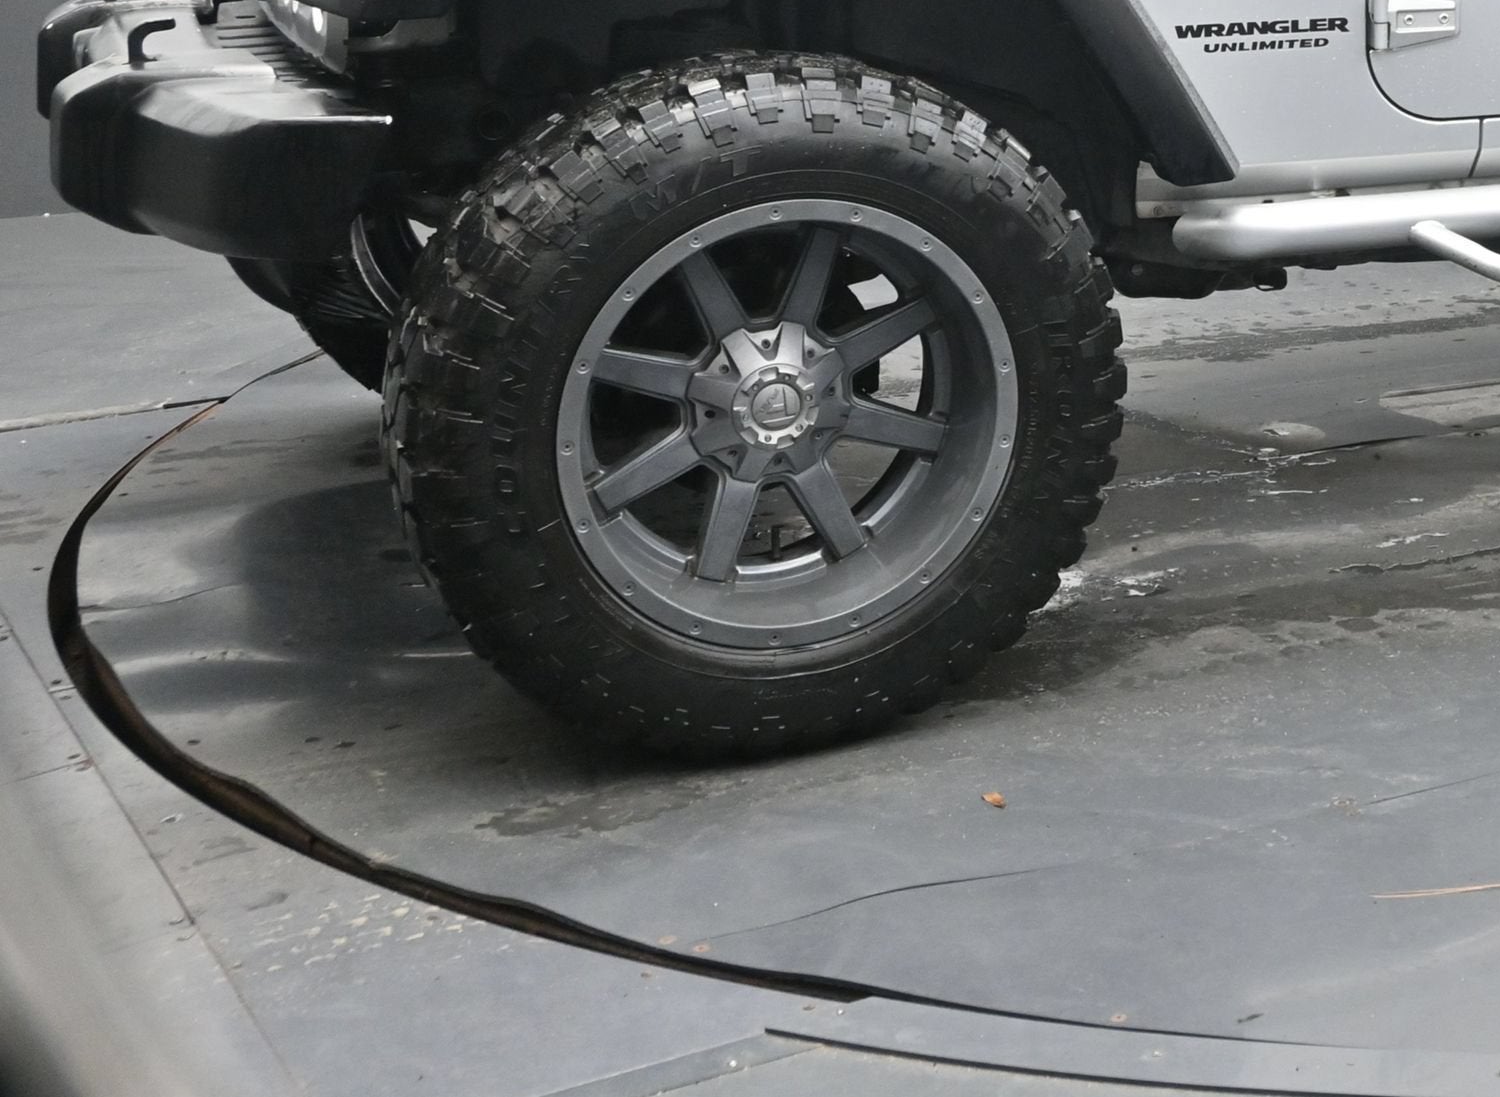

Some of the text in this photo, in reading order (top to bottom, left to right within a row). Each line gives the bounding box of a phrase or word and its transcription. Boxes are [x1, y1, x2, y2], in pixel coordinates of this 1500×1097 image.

[1174, 17, 1350, 39] WRANGLER
[1203, 38, 1330, 53] UNLIMITED
[628, 144, 764, 221] M/T
